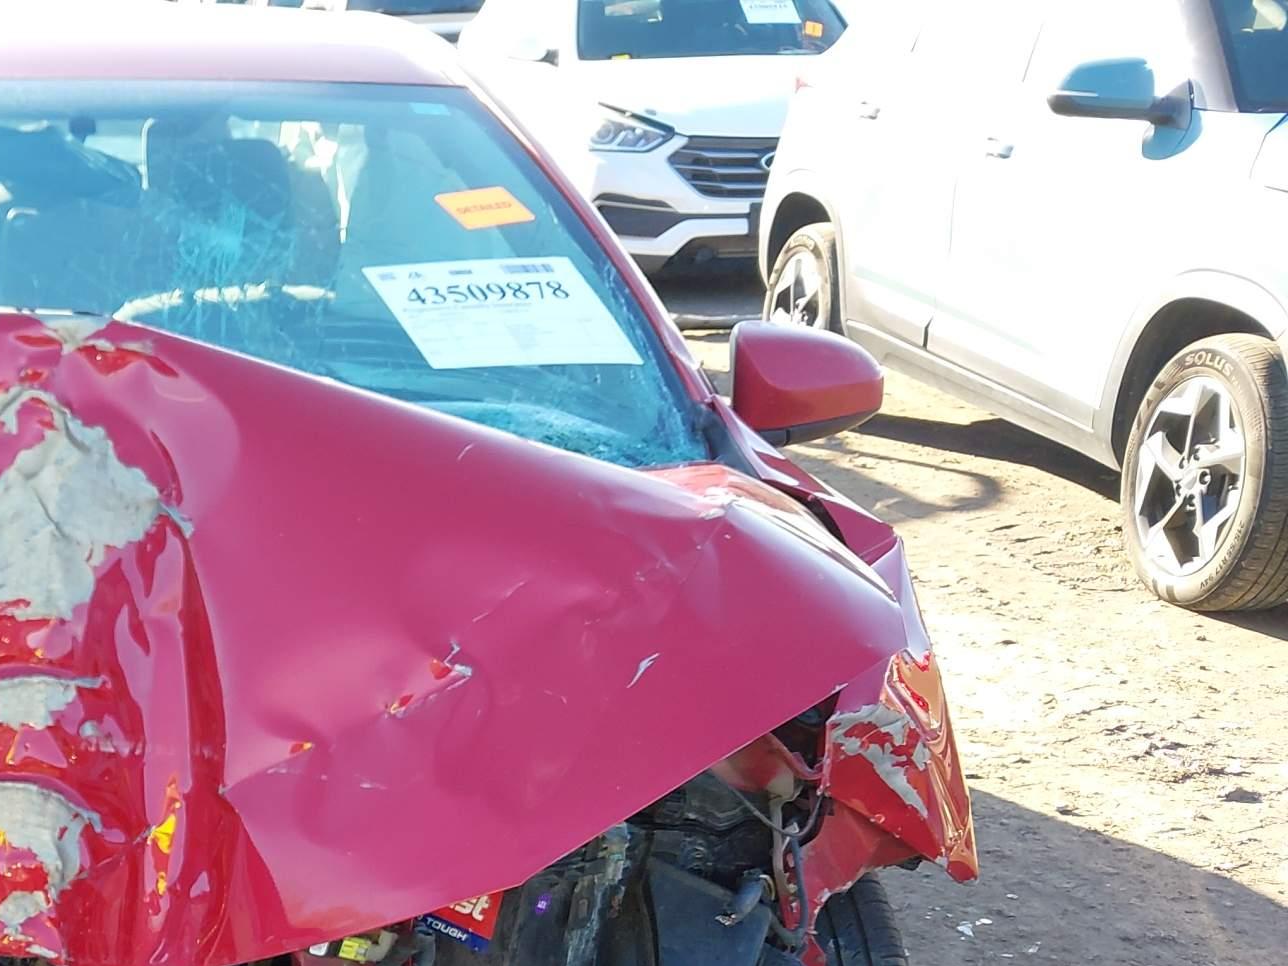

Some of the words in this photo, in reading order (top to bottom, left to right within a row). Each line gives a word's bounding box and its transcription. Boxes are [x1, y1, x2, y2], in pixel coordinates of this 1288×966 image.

[407, 281, 570, 305] 43509878
[1185, 351, 1234, 376] SOLUS
[426, 917, 469, 941] TOUGH
